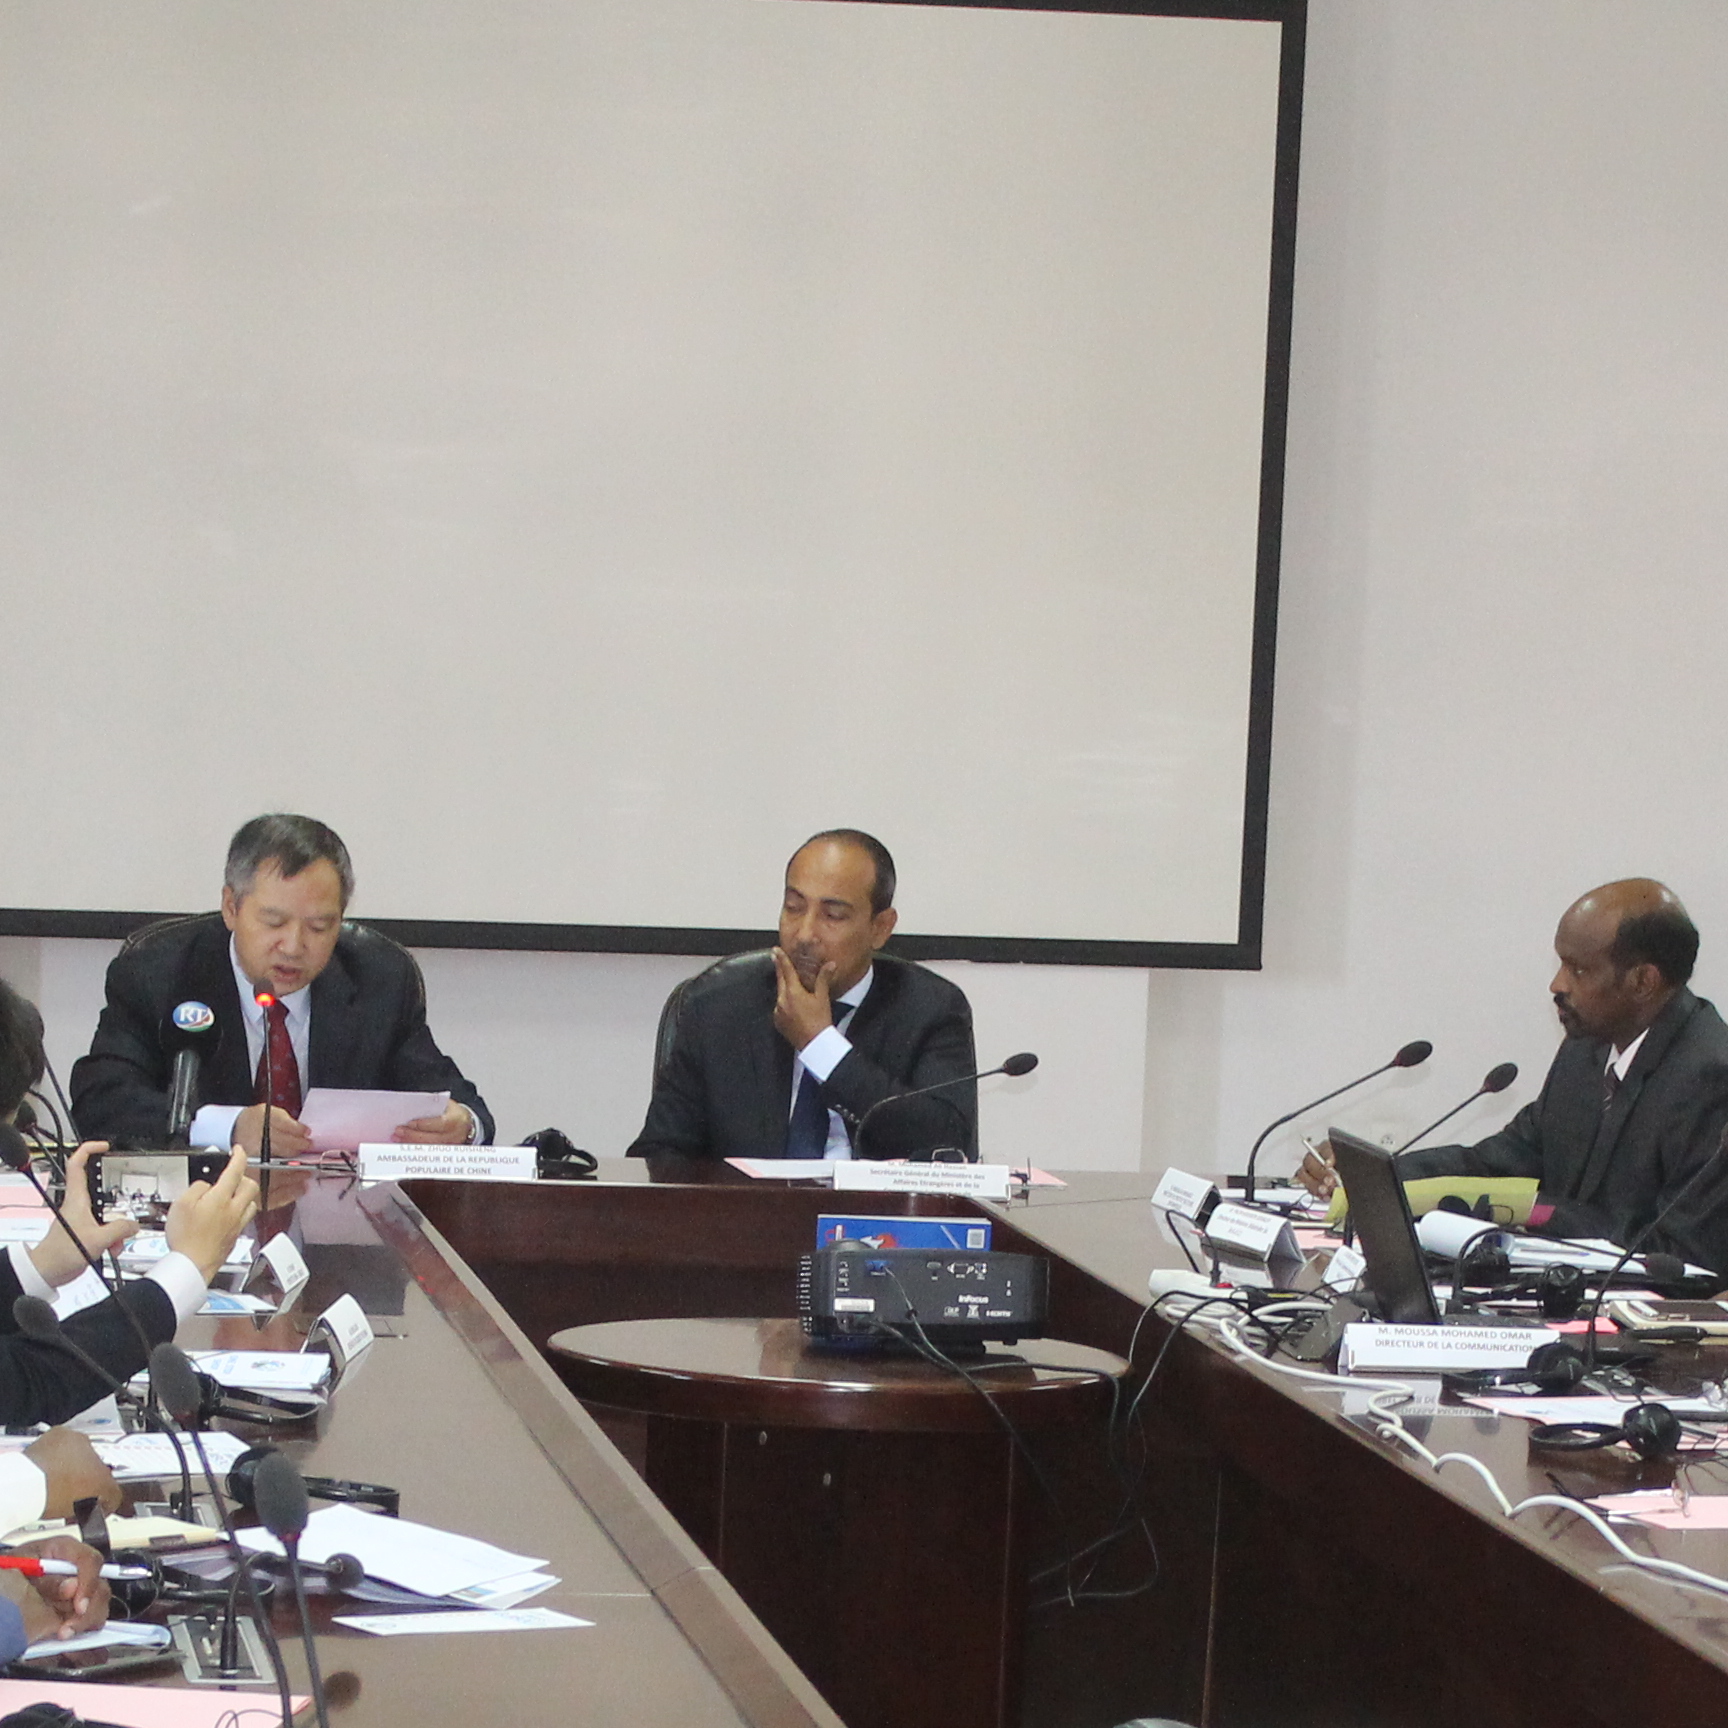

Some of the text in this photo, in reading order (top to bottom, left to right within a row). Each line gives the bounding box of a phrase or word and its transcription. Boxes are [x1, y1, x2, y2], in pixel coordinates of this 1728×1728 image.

[376, 1154, 441, 1164] AMBASSADEUR
[443, 1155, 455, 1164] DE
[456, 1156, 466, 1164] LA
[405, 1166, 492, 1176] POPULAIRE DE CHINE
[1378, 1326, 1533, 1341] M. MOUSSA MOHAMED OMAR
[1375, 1338, 1425, 1349] DIRECTEUR
[1427, 1340, 1439, 1350] DE
[1441, 1341, 1453, 1350] LA
